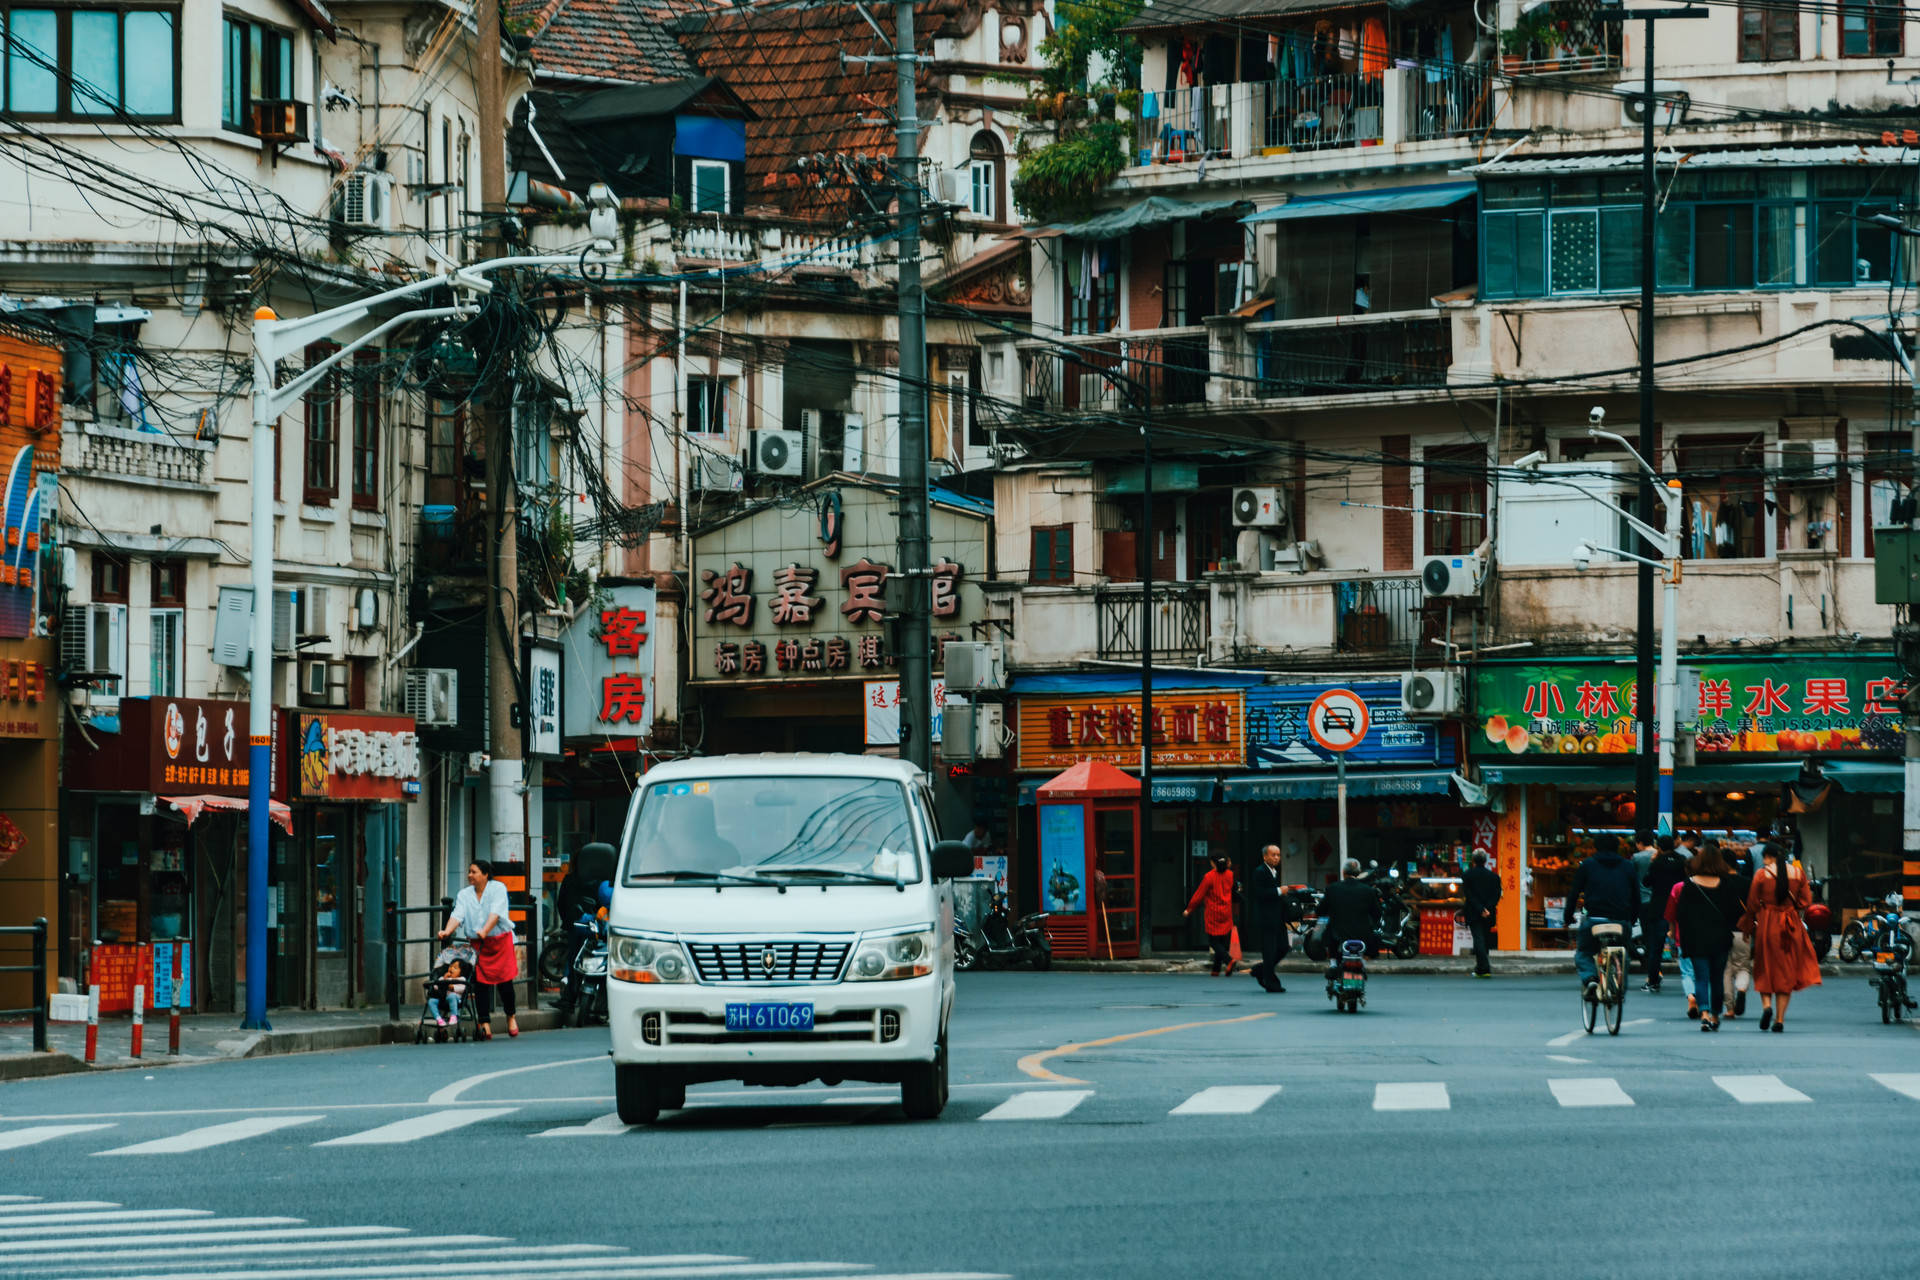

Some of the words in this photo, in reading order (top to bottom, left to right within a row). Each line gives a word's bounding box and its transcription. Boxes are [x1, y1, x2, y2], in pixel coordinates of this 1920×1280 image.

[598, 606, 648, 723] 客房
[714, 640, 766, 673] 标房
[775, 636, 850, 671] 钟点房
[1047, 700, 1232, 746] 重庆特色面馆
[1246, 706, 1312, 744] 角餐
[1528, 719, 1600, 735] 真诚服务
[1737, 717, 1774, 733] 果篮
